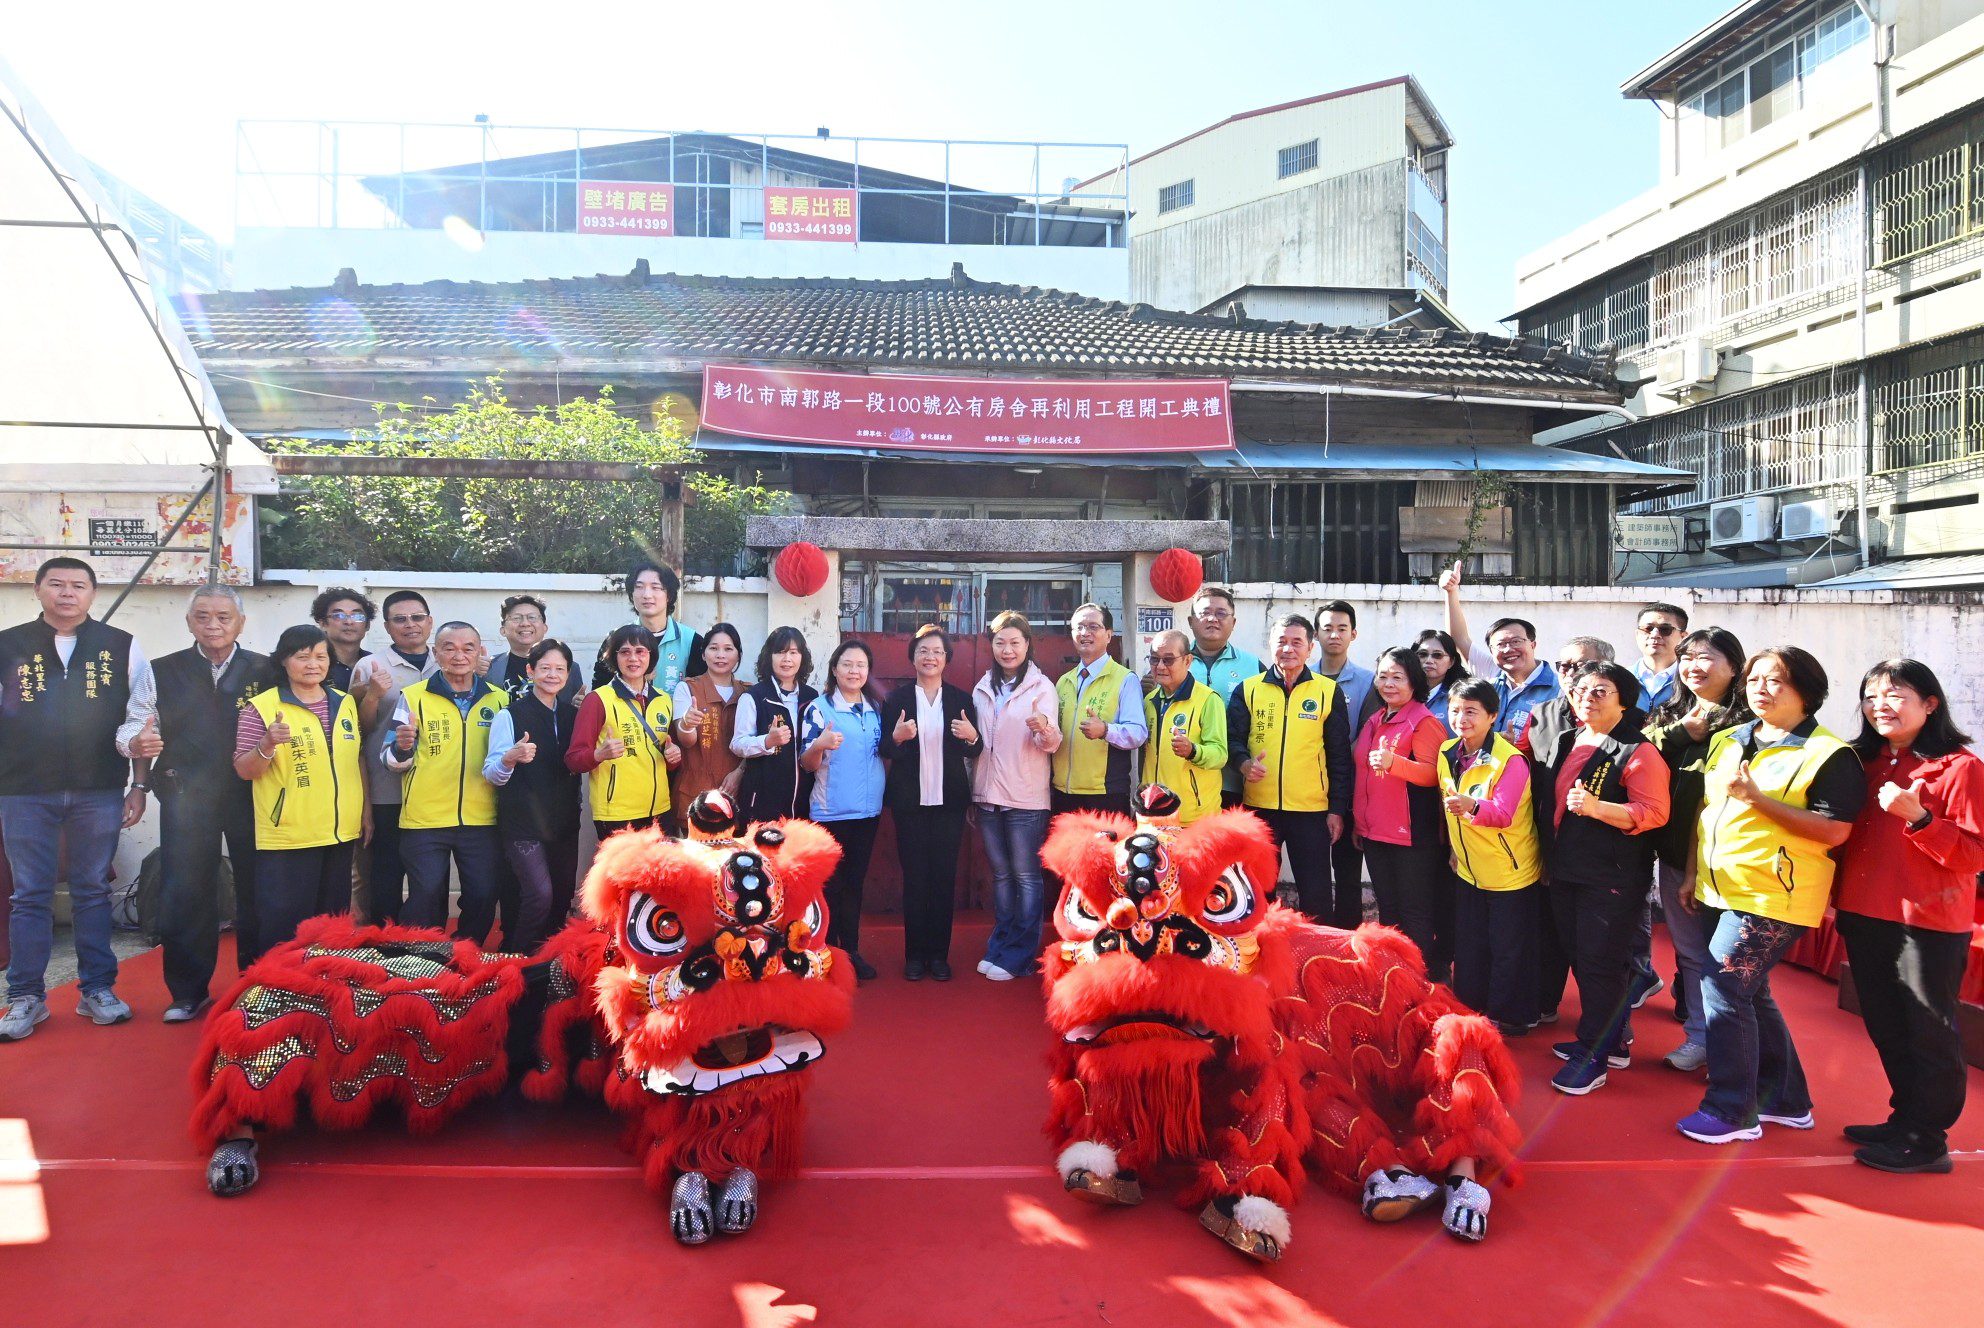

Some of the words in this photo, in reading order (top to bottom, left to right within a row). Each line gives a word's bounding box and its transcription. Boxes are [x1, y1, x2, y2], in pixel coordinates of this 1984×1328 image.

[769, 195, 852, 218] 套房出租
[583, 216, 668, 230] 0933-441399
[769, 221, 852, 235] 0933-441399
[712, 380, 1223, 420] 彰化市南郭路一段100號公有房舍再利用工程開工典禮
[1627, 523, 1679, 532] 建築師事務所
[1147, 617, 1171, 632] 100
[85, 661, 98, 699] 服務團隊
[98, 650, 114, 686] 陳文賓
[17, 664, 35, 702] 陳志忠
[427, 719, 441, 757] 劉信邦
